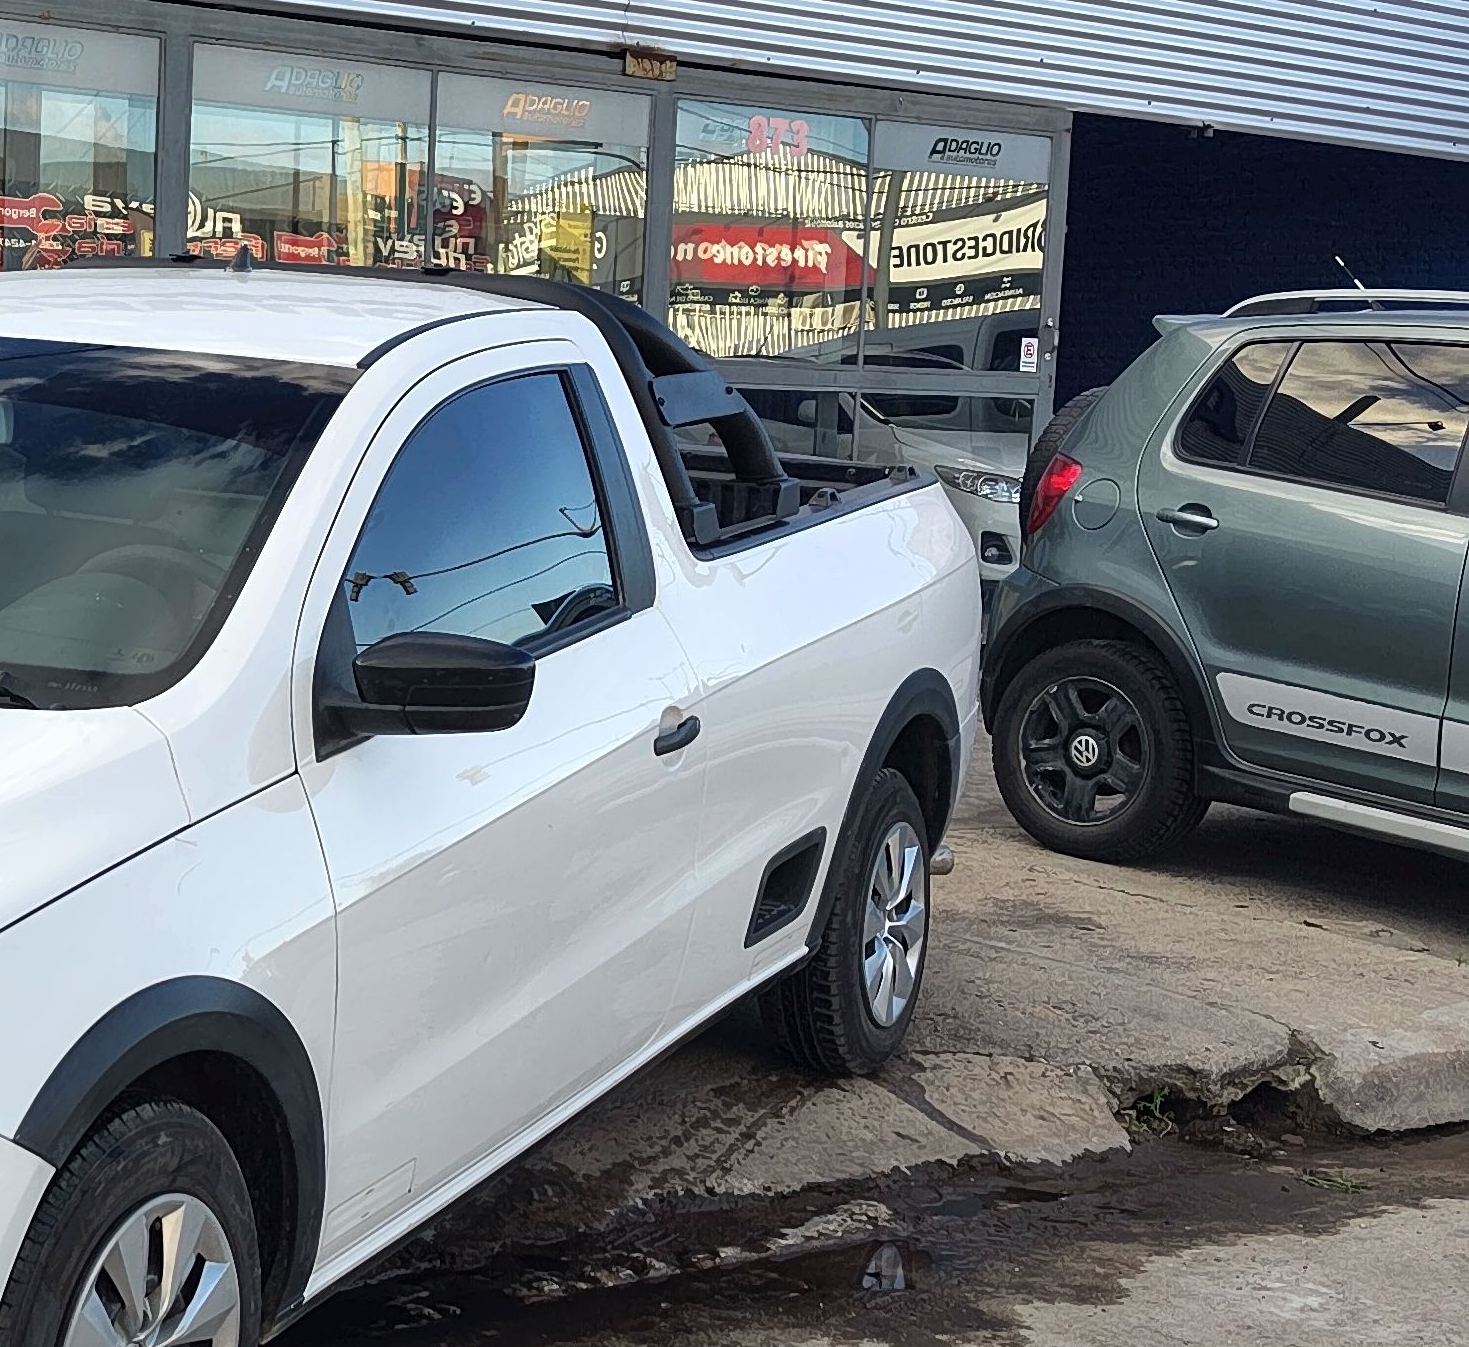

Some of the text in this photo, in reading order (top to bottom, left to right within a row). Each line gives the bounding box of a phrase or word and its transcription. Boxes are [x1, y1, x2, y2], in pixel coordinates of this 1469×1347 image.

[265, 64, 364, 92] ADAGLIO
[502, 93, 591, 121] ADAGLIO
[747, 114, 810, 156] 873
[929, 137, 1002, 160] ADAGLIO
[1246, 702, 1410, 750] CROSSFOX
